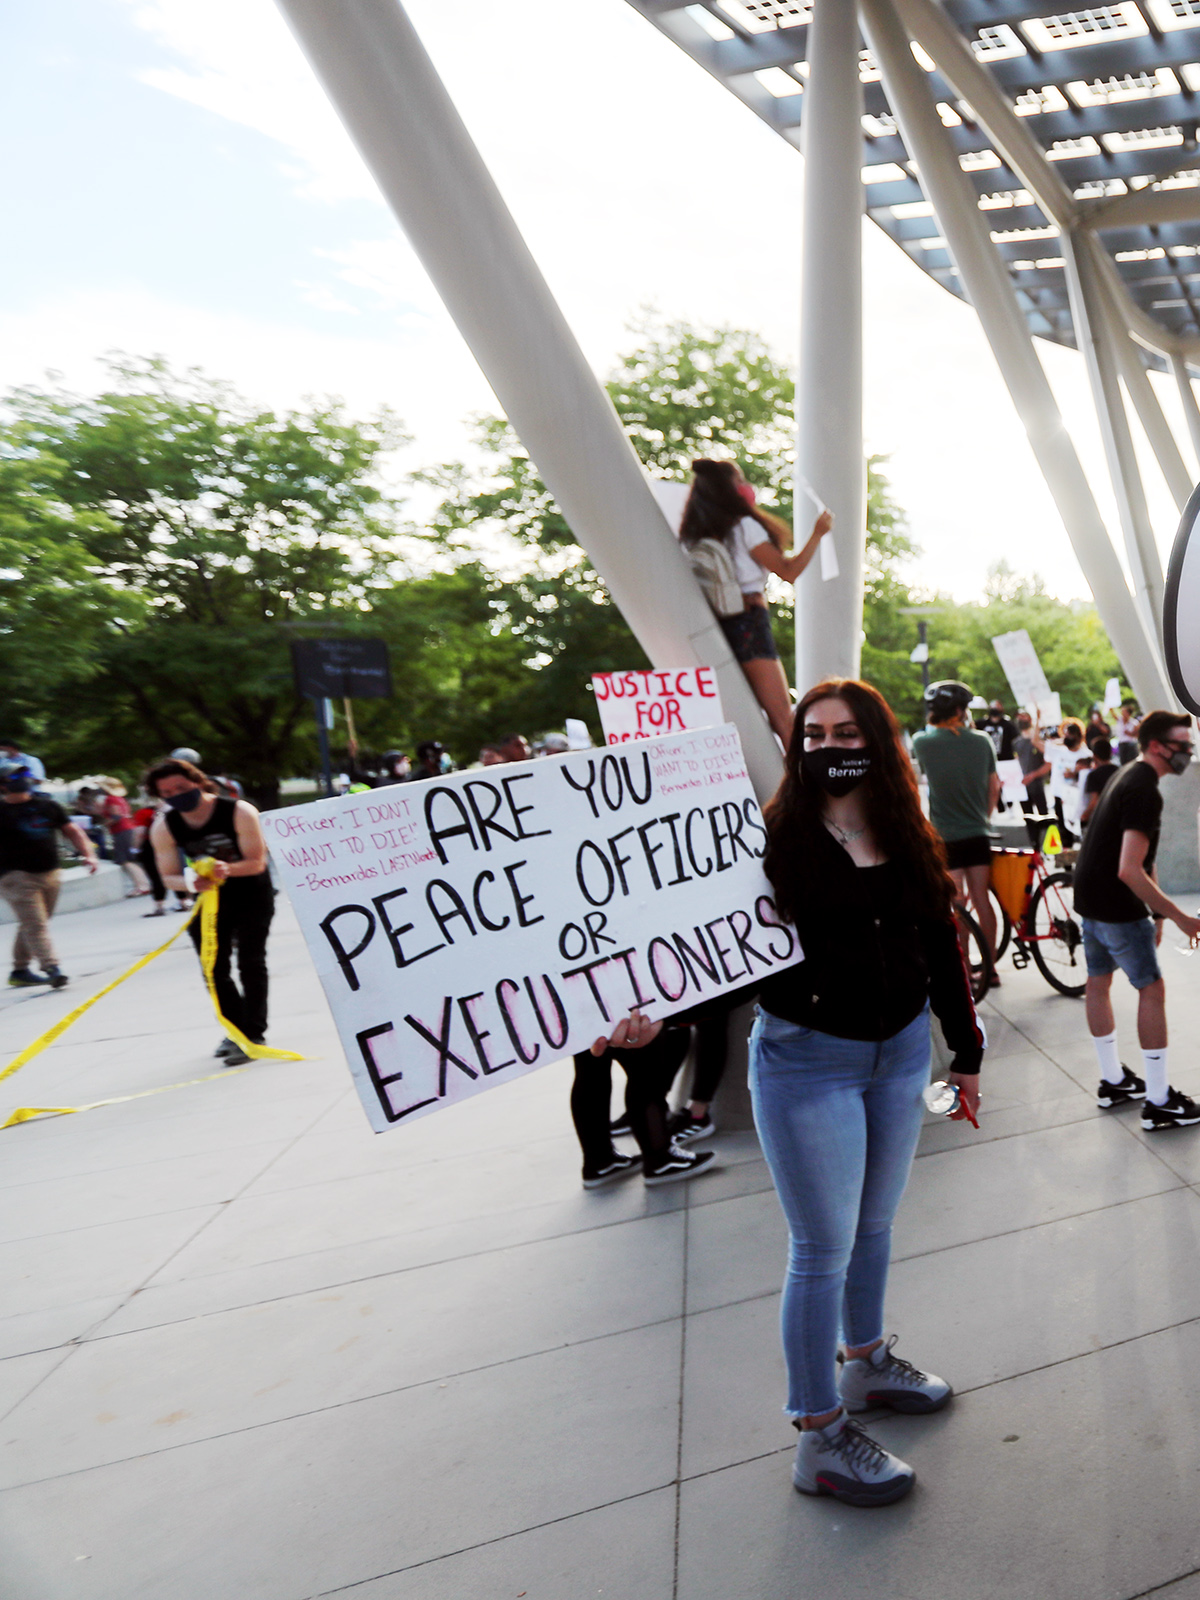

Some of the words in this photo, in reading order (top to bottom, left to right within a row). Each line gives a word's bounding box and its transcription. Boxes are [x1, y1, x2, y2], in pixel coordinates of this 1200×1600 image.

[591, 667, 716, 701] JUSTICE
[636, 698, 686, 730] FOR
[343, 807, 363, 829] I
[424, 773, 552, 865] ARE
[560, 752, 652, 818] YOU
[280, 843, 337, 868] WANT
[340, 836, 365, 854] TO
[320, 861, 545, 991] PEACE
[576, 797, 770, 906] OFFICERS
[559, 911, 617, 961] OR
[356, 895, 795, 1122] EXECUTIONERS
